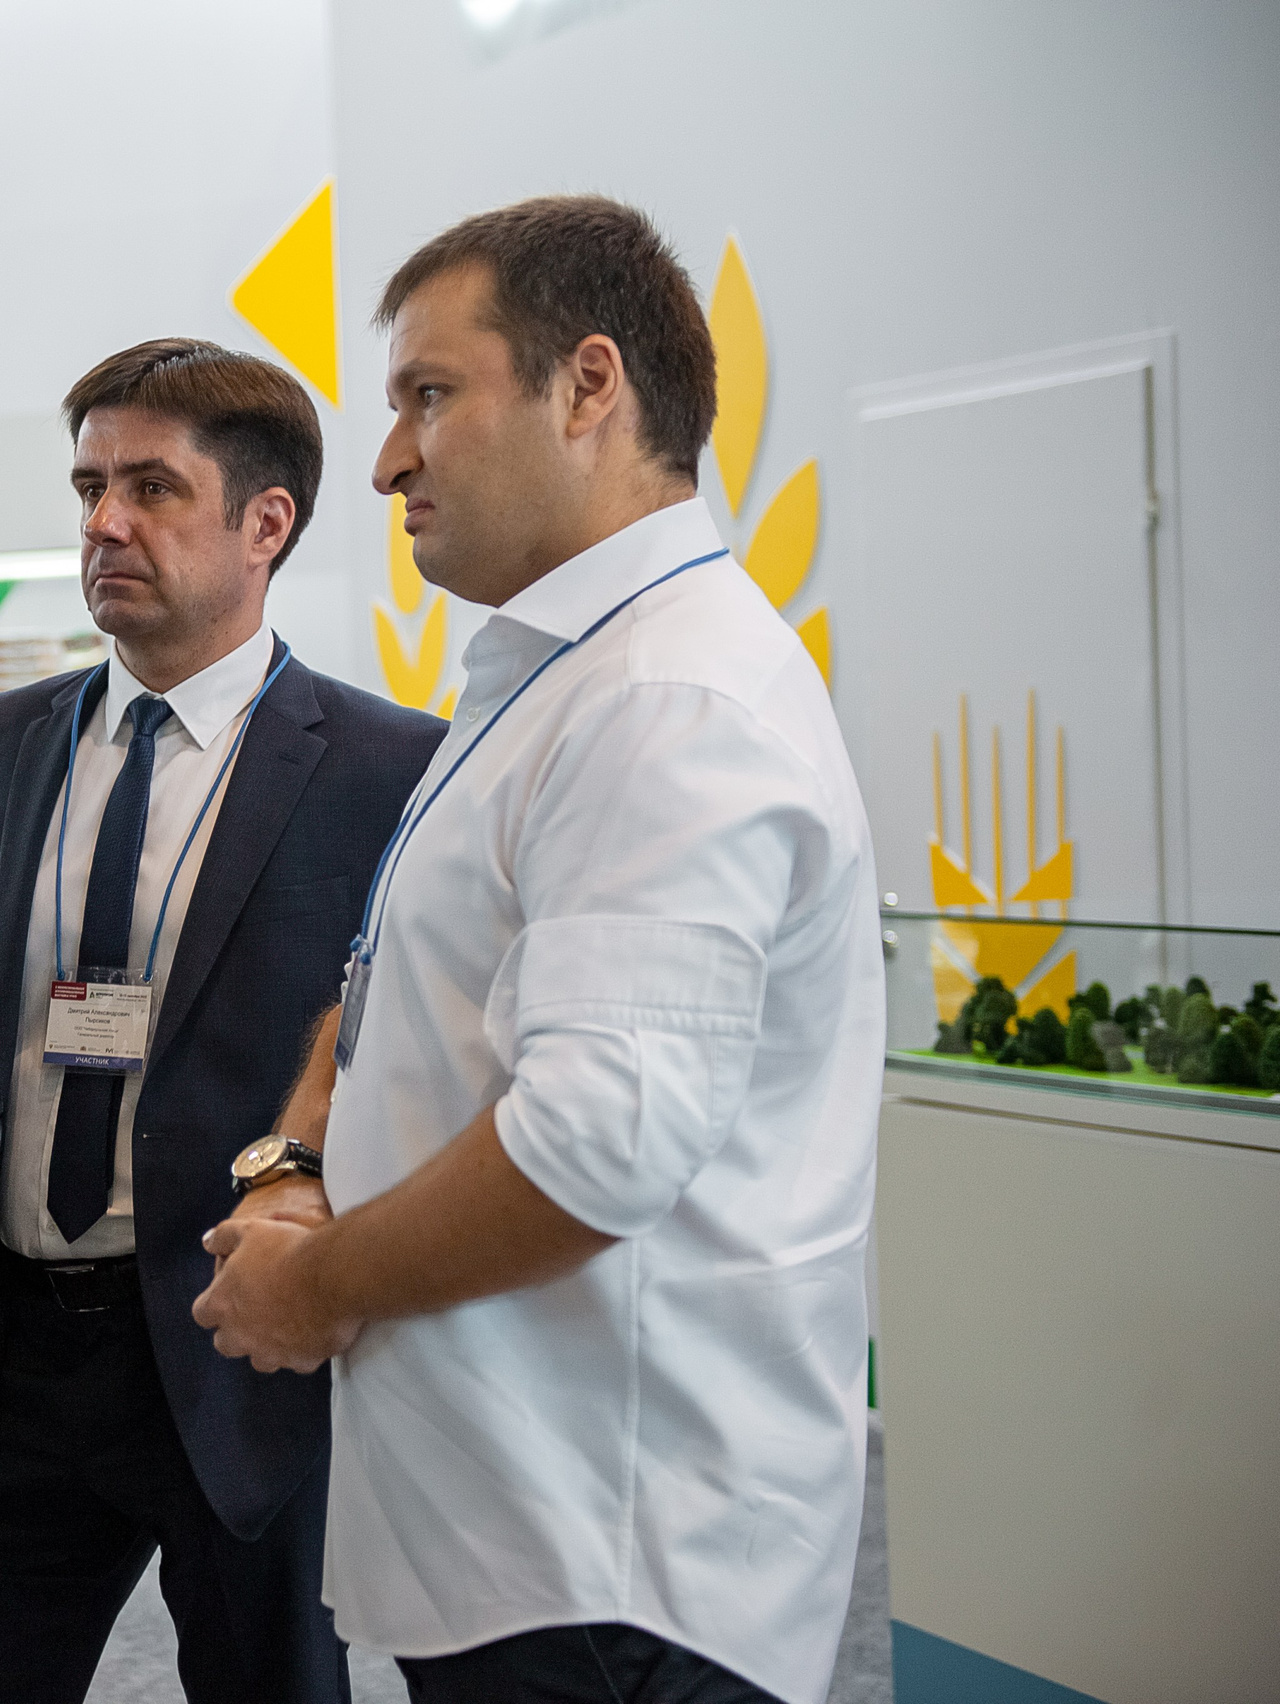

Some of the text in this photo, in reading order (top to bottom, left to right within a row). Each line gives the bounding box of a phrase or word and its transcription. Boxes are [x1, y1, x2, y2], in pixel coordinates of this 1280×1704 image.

[67, 1007, 130, 1017] Дмитрий Александрович
[75, 1056, 110, 1065] УЧАСТНИК
